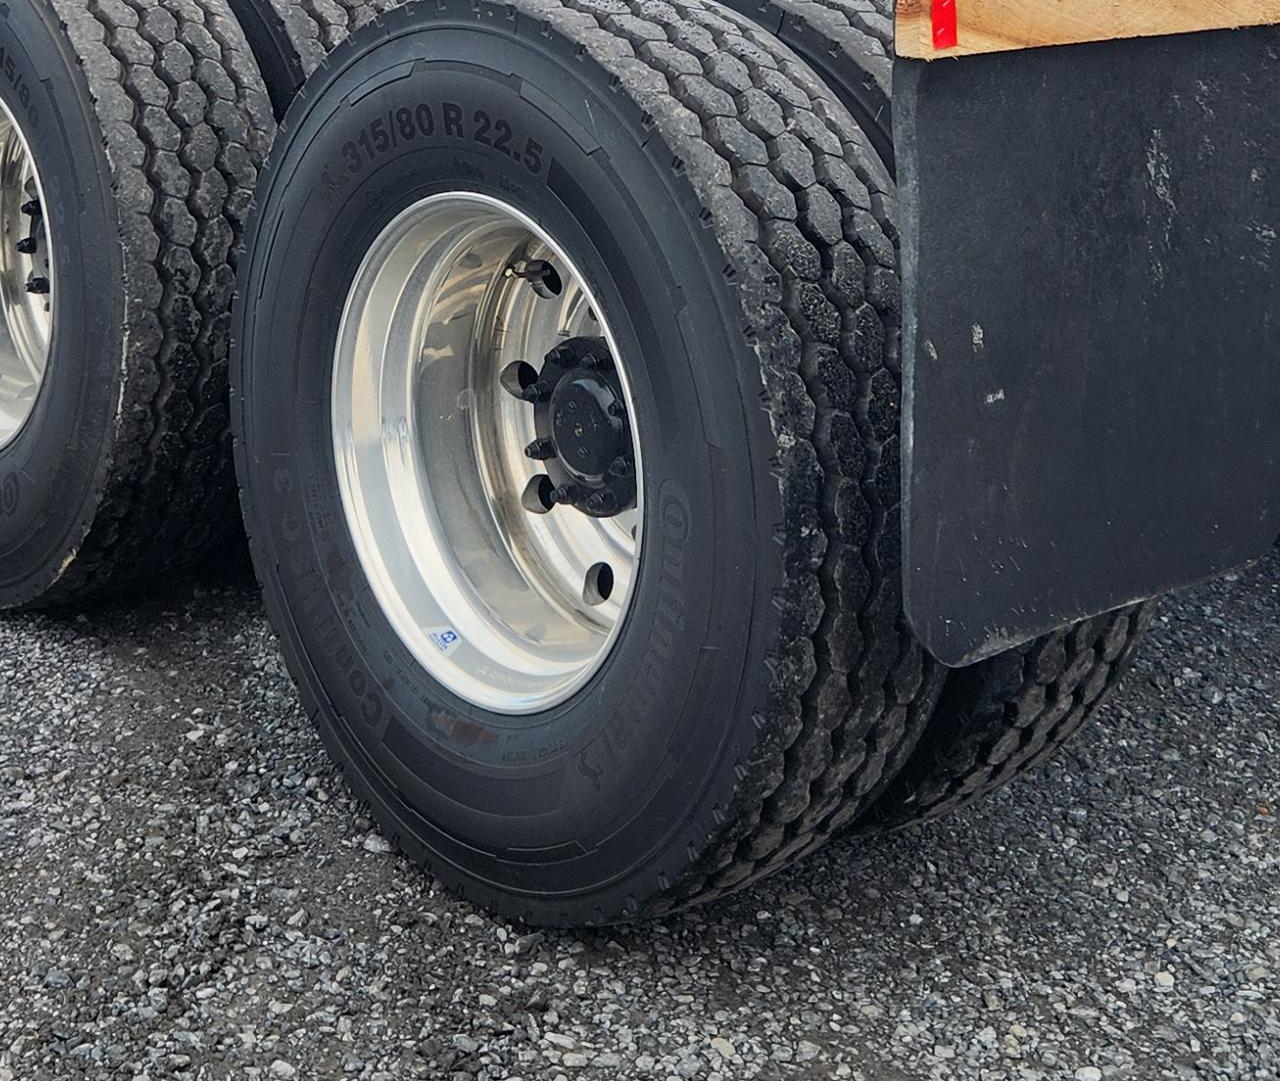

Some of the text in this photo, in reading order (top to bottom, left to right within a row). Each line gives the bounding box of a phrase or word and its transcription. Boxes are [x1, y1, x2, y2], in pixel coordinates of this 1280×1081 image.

[342, 102, 544, 175] 315/80 R 22.5
